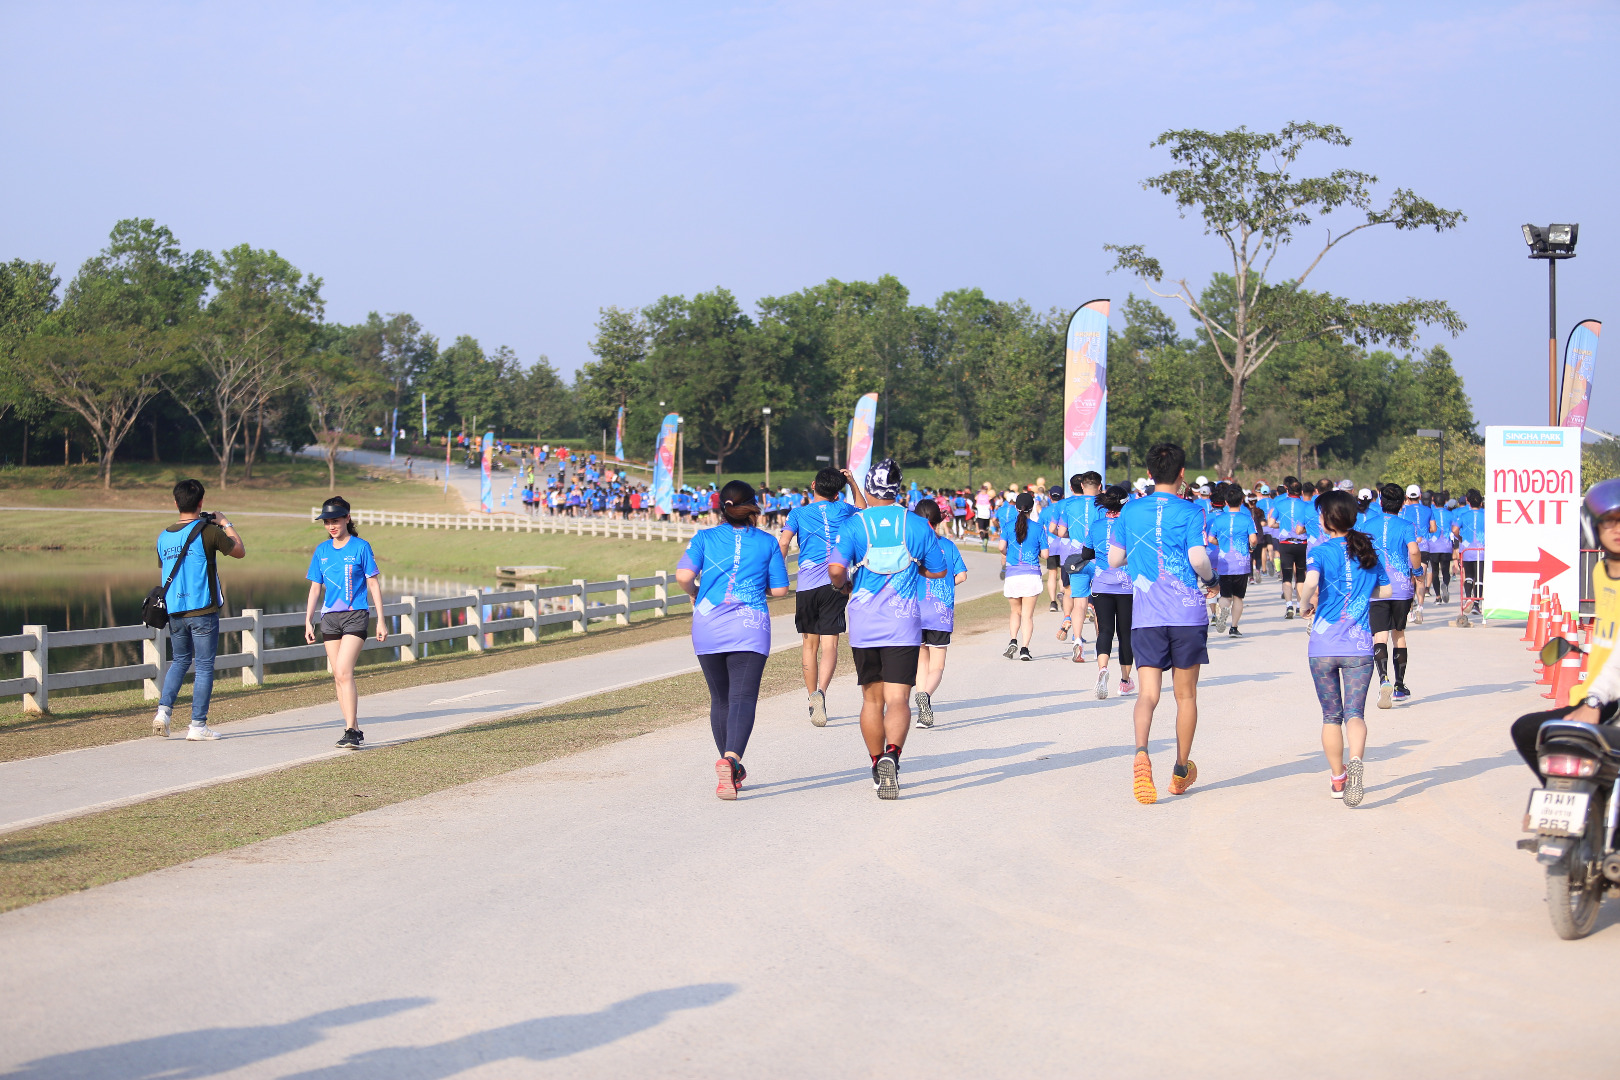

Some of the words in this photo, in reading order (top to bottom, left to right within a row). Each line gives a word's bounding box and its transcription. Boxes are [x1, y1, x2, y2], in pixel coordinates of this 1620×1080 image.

[1505, 432, 1539, 440] SINGHA
[1540, 433, 1561, 441] PARK
[1493, 469, 1573, 494] ทางออก
[1496, 499, 1568, 525] EXIT
[1155, 527, 1163, 545] BEAT
[733, 555, 742, 571] BEAT
[1157, 546, 1166, 581] YOURSELF
[1539, 818, 1570, 831] 263
